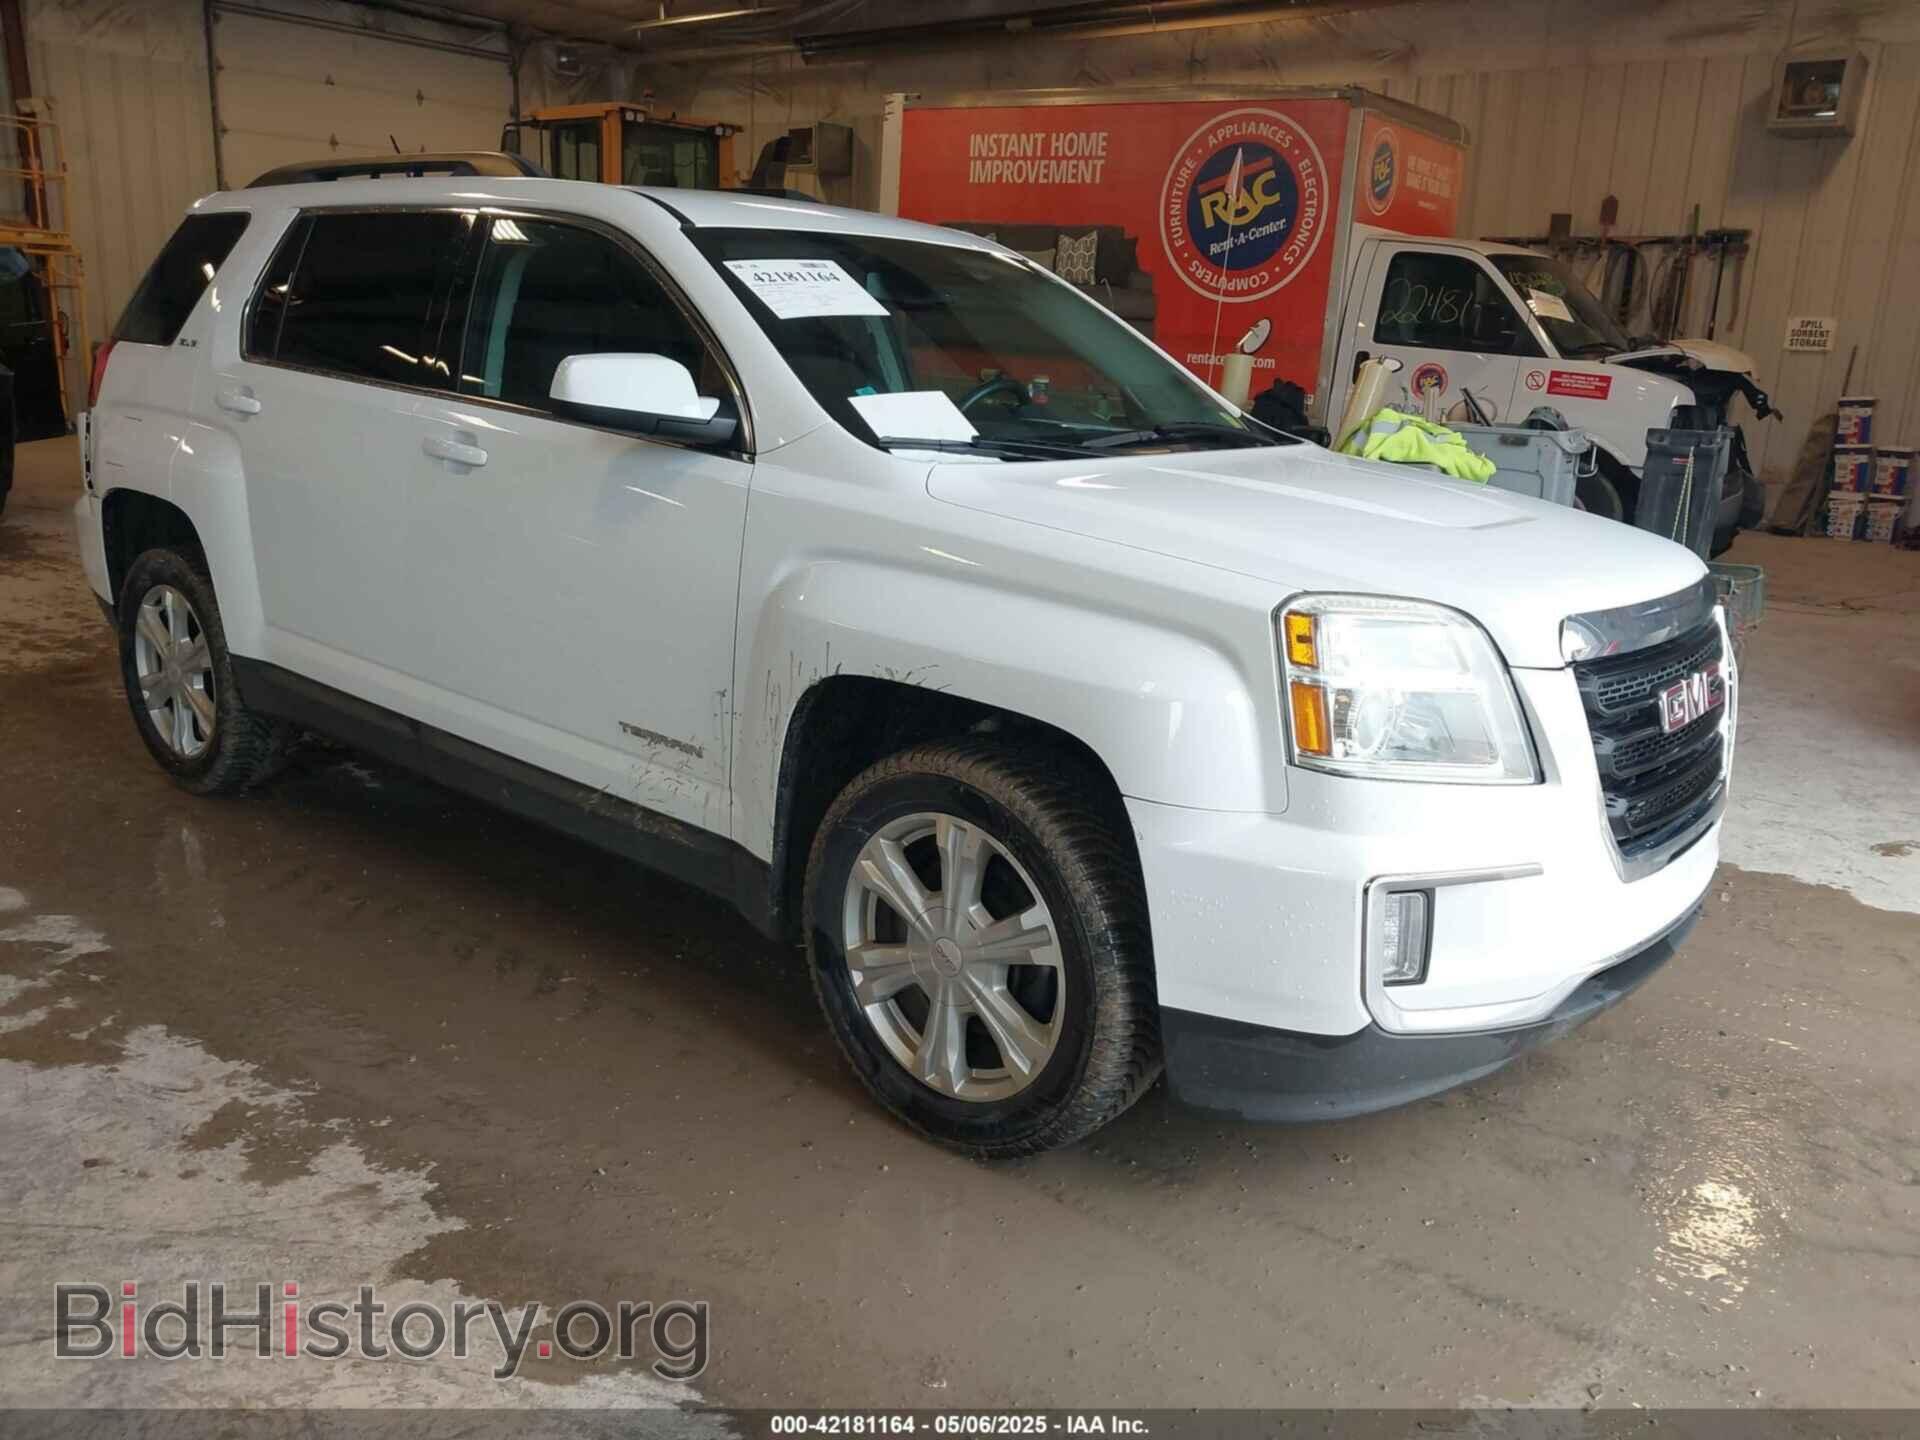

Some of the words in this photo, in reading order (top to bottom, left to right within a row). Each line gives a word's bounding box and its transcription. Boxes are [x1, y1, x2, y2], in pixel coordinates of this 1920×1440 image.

[970, 133, 1046, 158] INSTANT
[1050, 131, 1108, 157] HOME
[1207, 121, 1293, 149] APPLIANCES
[969, 159, 1105, 184] IMPROVEMENT
[1169, 157, 1197, 247] FURNITURE
[1200, 170, 1280, 229] RAC
[1283, 158, 1317, 264] ELECTRONICS
[753, 271, 841, 283] 42181164
[1188, 259, 1270, 291] COMPUTERS
[1800, 319, 1824, 329] SPILL
[1788, 338, 1828, 348] STORAGE
[1661, 664, 1724, 733] GMC
